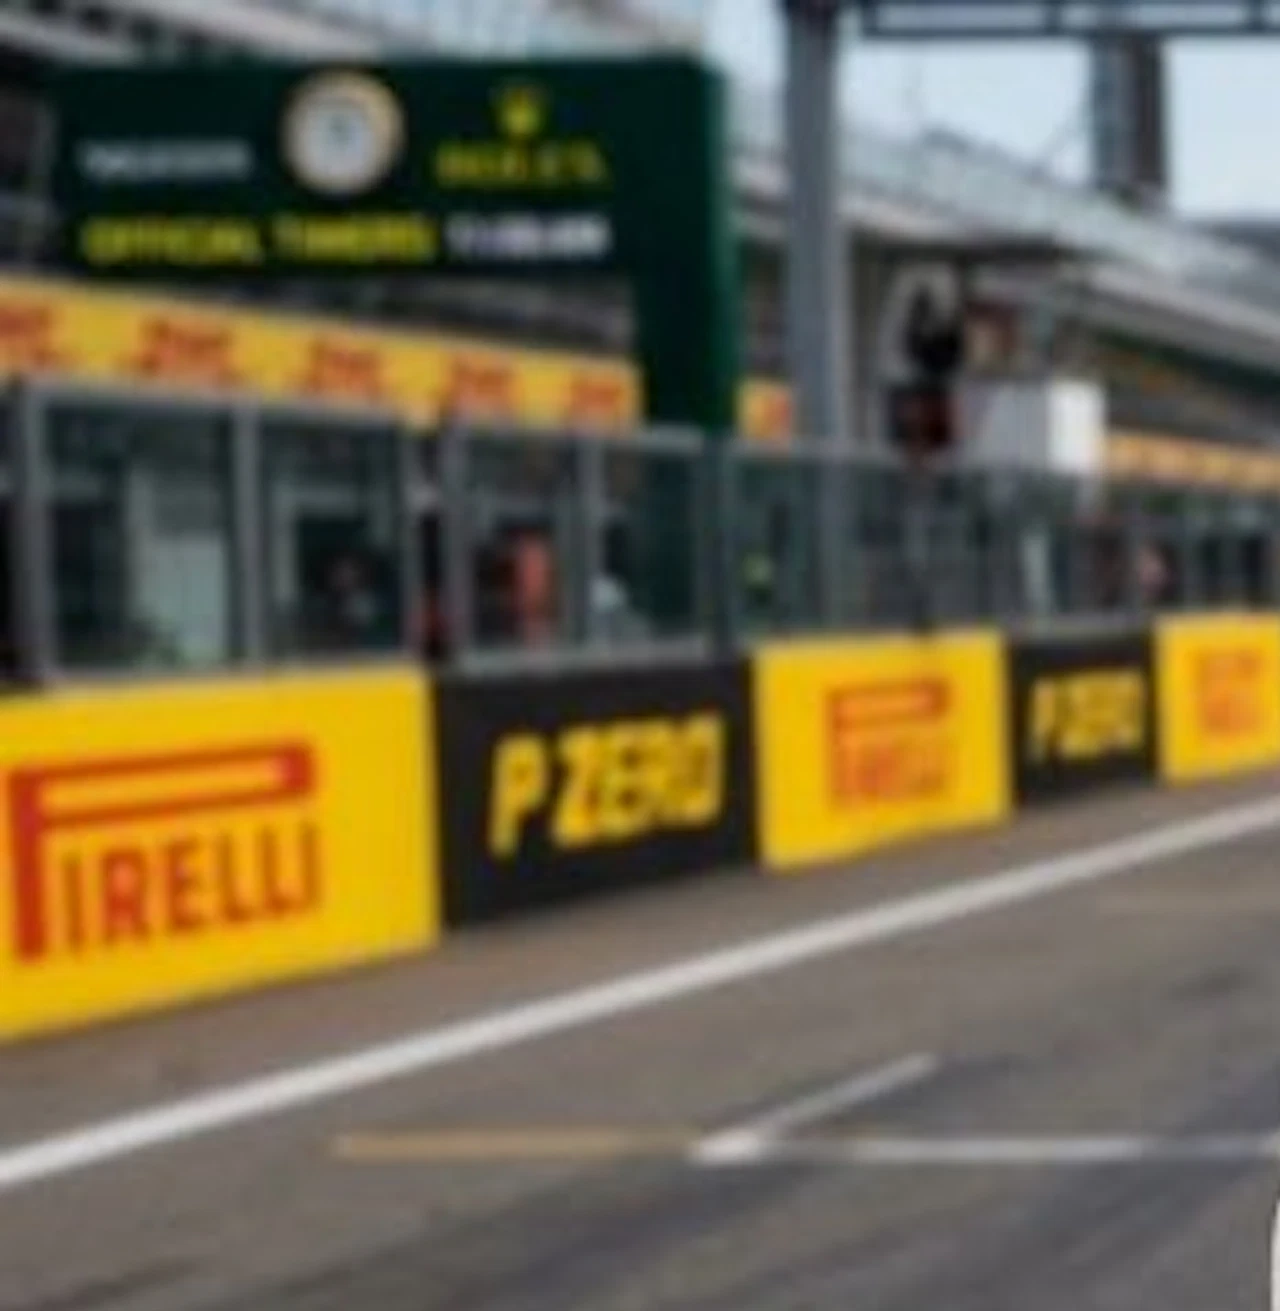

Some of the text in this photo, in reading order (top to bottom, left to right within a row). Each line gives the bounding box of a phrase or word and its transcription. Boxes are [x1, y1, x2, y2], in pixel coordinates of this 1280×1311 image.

[8, 740, 320, 963] PIRELLI
[490, 708, 727, 857] P ZERO
